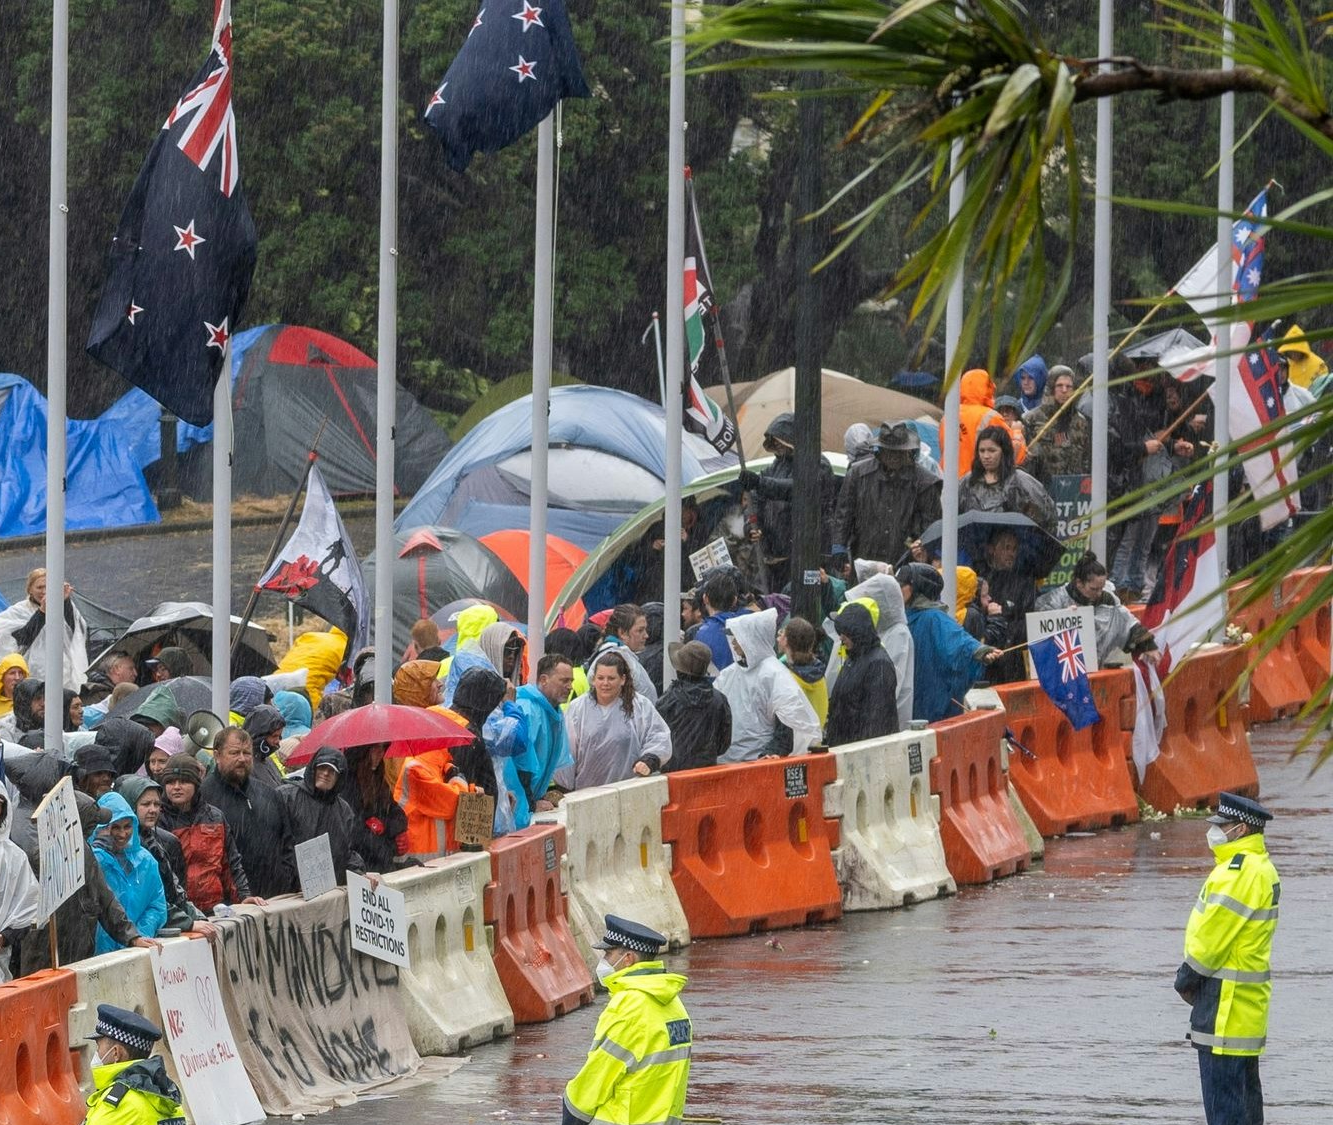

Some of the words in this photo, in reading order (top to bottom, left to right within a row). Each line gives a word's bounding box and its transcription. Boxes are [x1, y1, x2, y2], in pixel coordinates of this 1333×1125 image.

[1040, 619, 1054, 634] NO
[1056, 616, 1082, 632] MORE
[362, 888, 377, 908] END
[378, 894, 391, 913] ALL
[361, 908, 395, 933] COVID-19
[355, 924, 405, 957] RESTRICTIONS
